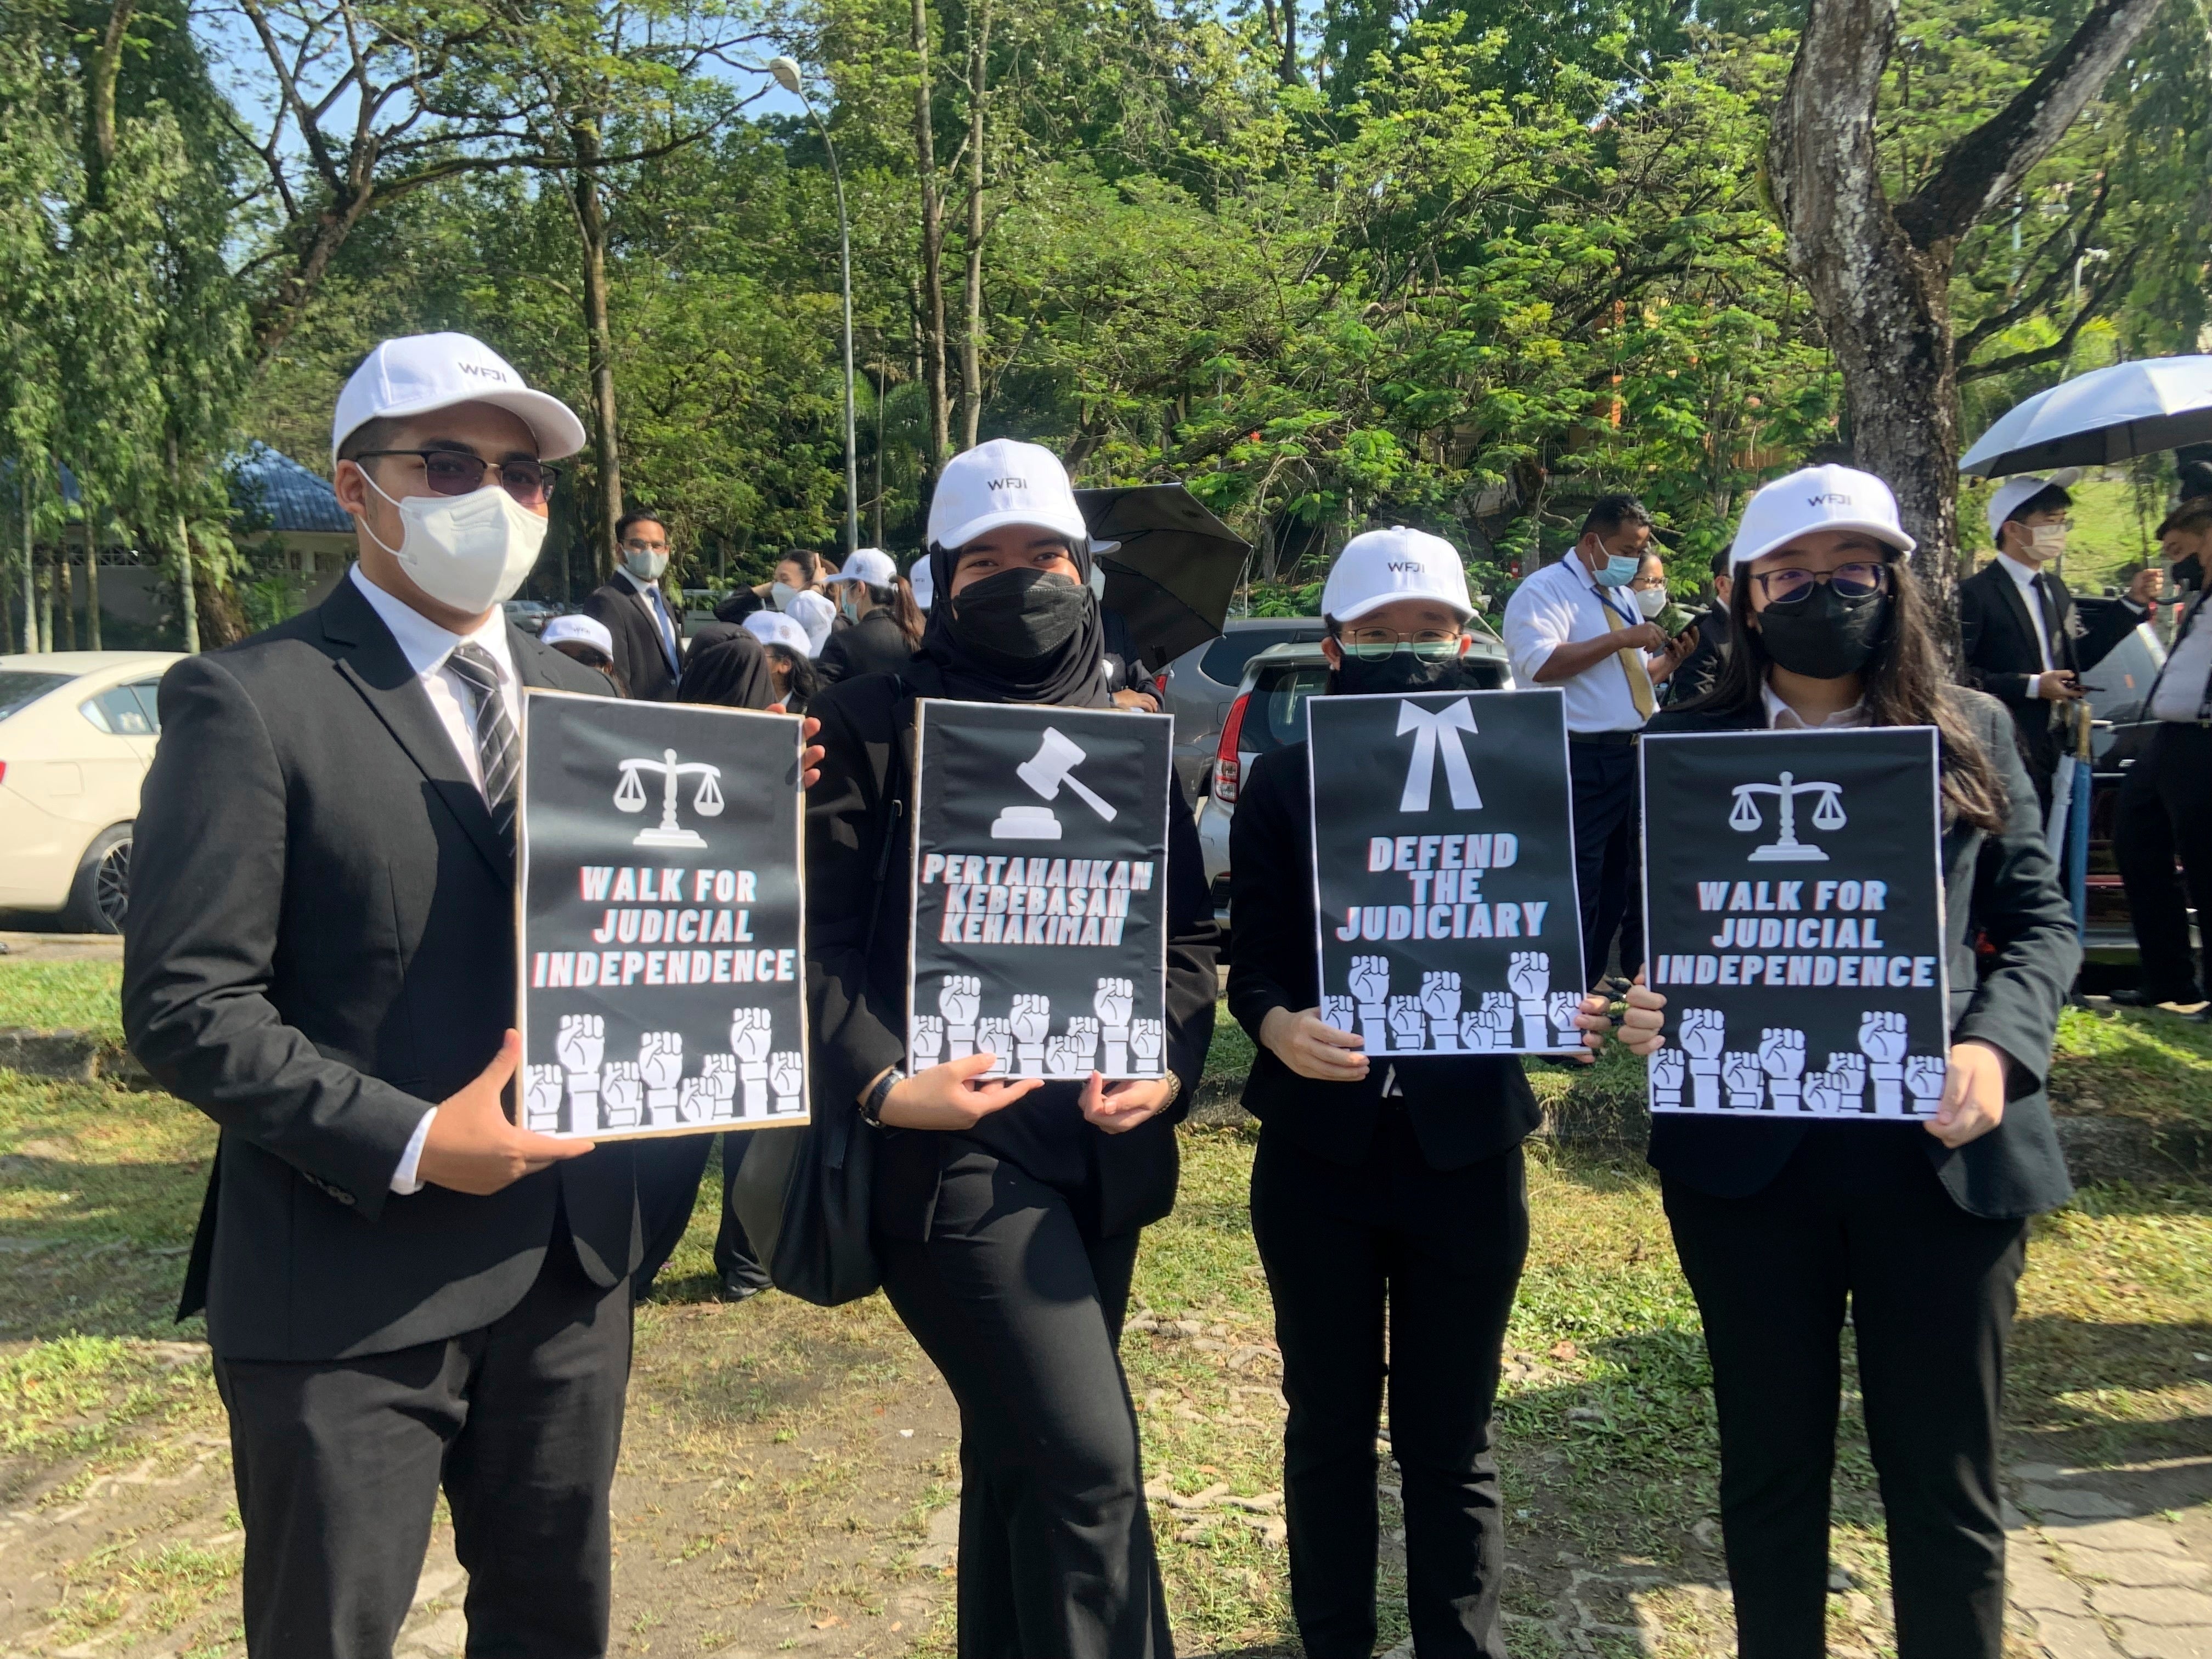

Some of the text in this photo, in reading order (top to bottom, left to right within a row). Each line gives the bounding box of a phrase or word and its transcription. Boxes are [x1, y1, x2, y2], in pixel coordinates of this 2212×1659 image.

[458, 362, 507, 383] WFJI
[988, 477, 1027, 491] WFJI
[1808, 493, 1852, 506] WFJI
[1388, 561, 1425, 572] WFJI
[1367, 833, 1519, 872] DEFEND
[579, 866, 758, 902] WALK FOR
[922, 854, 1154, 890] PERTAHANKAN
[1408, 868, 1484, 905] THE
[945, 884, 1131, 917] KEBEBASAN
[1697, 880, 1888, 911] WALK FOR
[592, 909, 754, 944] JUDICIAL
[939, 912, 1124, 946] KEHAKIMAN
[1335, 901, 1549, 942] JUDICIARY
[1711, 918, 1884, 949] JUDICIAL
[531, 949, 796, 988] INDEPENDENCE
[1655, 955, 1937, 987] INDEPENDENCE
